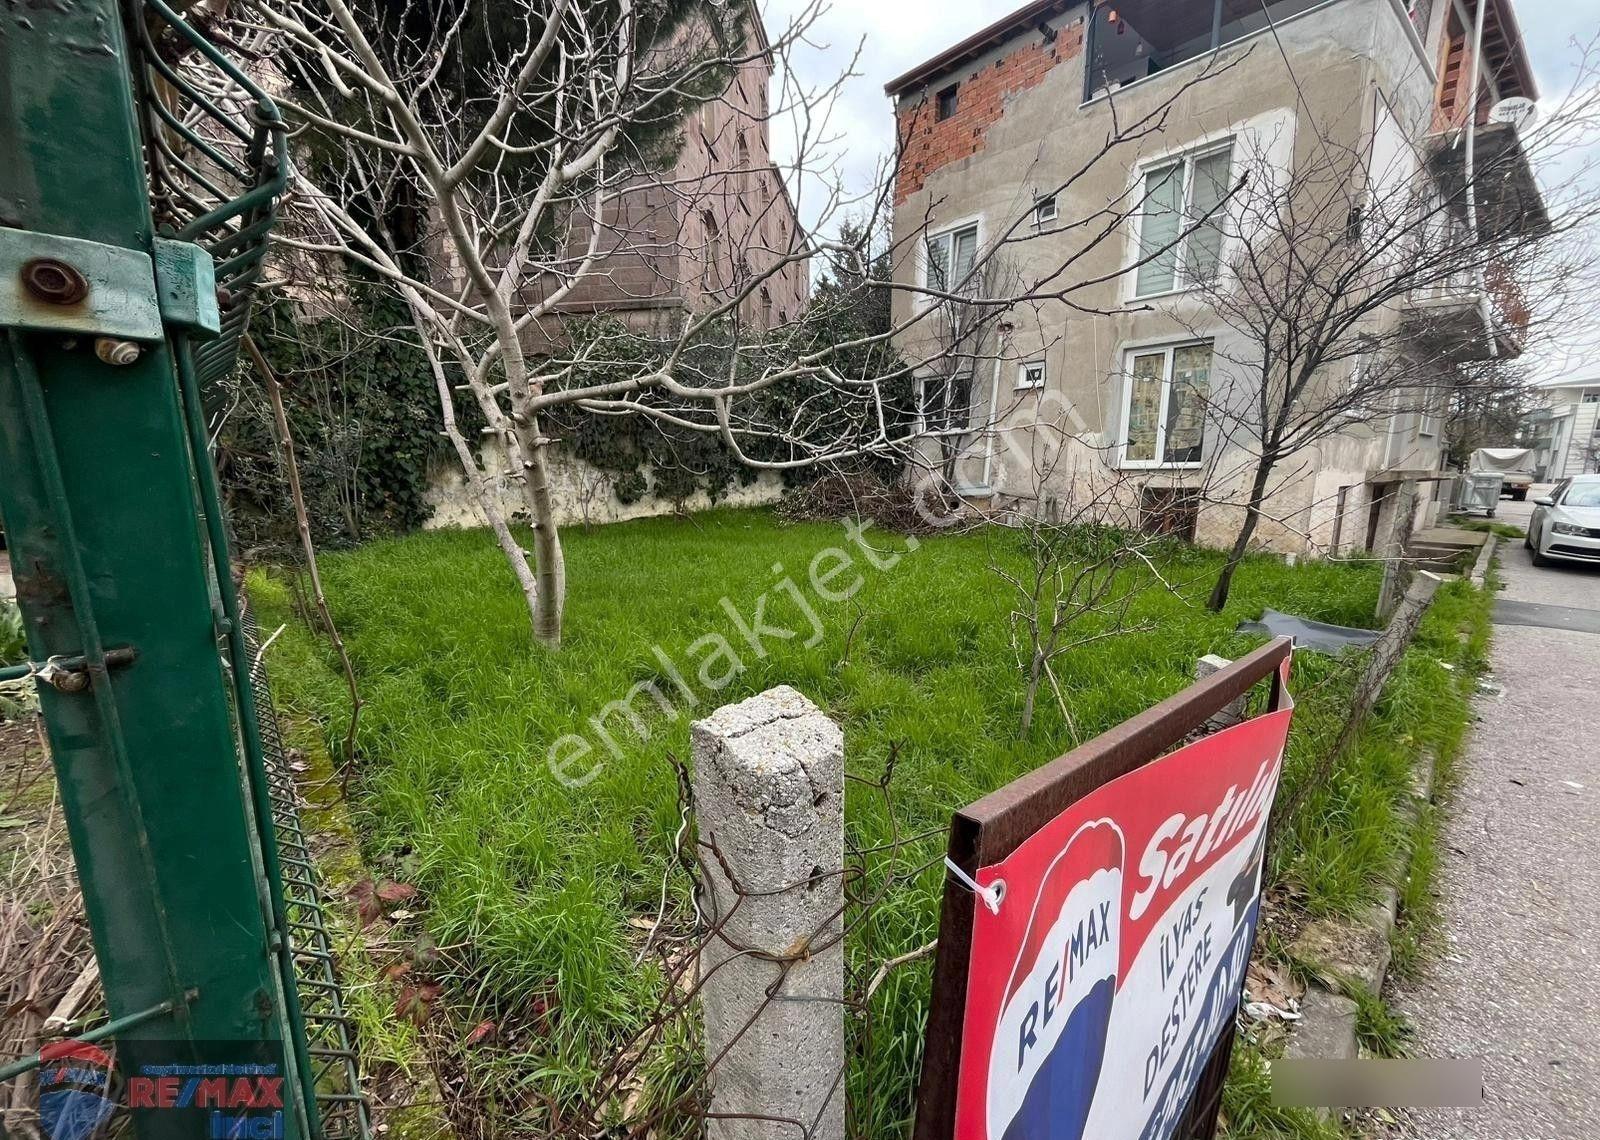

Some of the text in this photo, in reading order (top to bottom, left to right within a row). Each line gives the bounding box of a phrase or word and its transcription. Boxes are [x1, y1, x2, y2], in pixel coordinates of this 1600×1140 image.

[1017, 899, 1112, 1074] RE/MAX
[1143, 921, 1212, 1104] DESTERE
[1160, 887, 1208, 992] İLYAS
